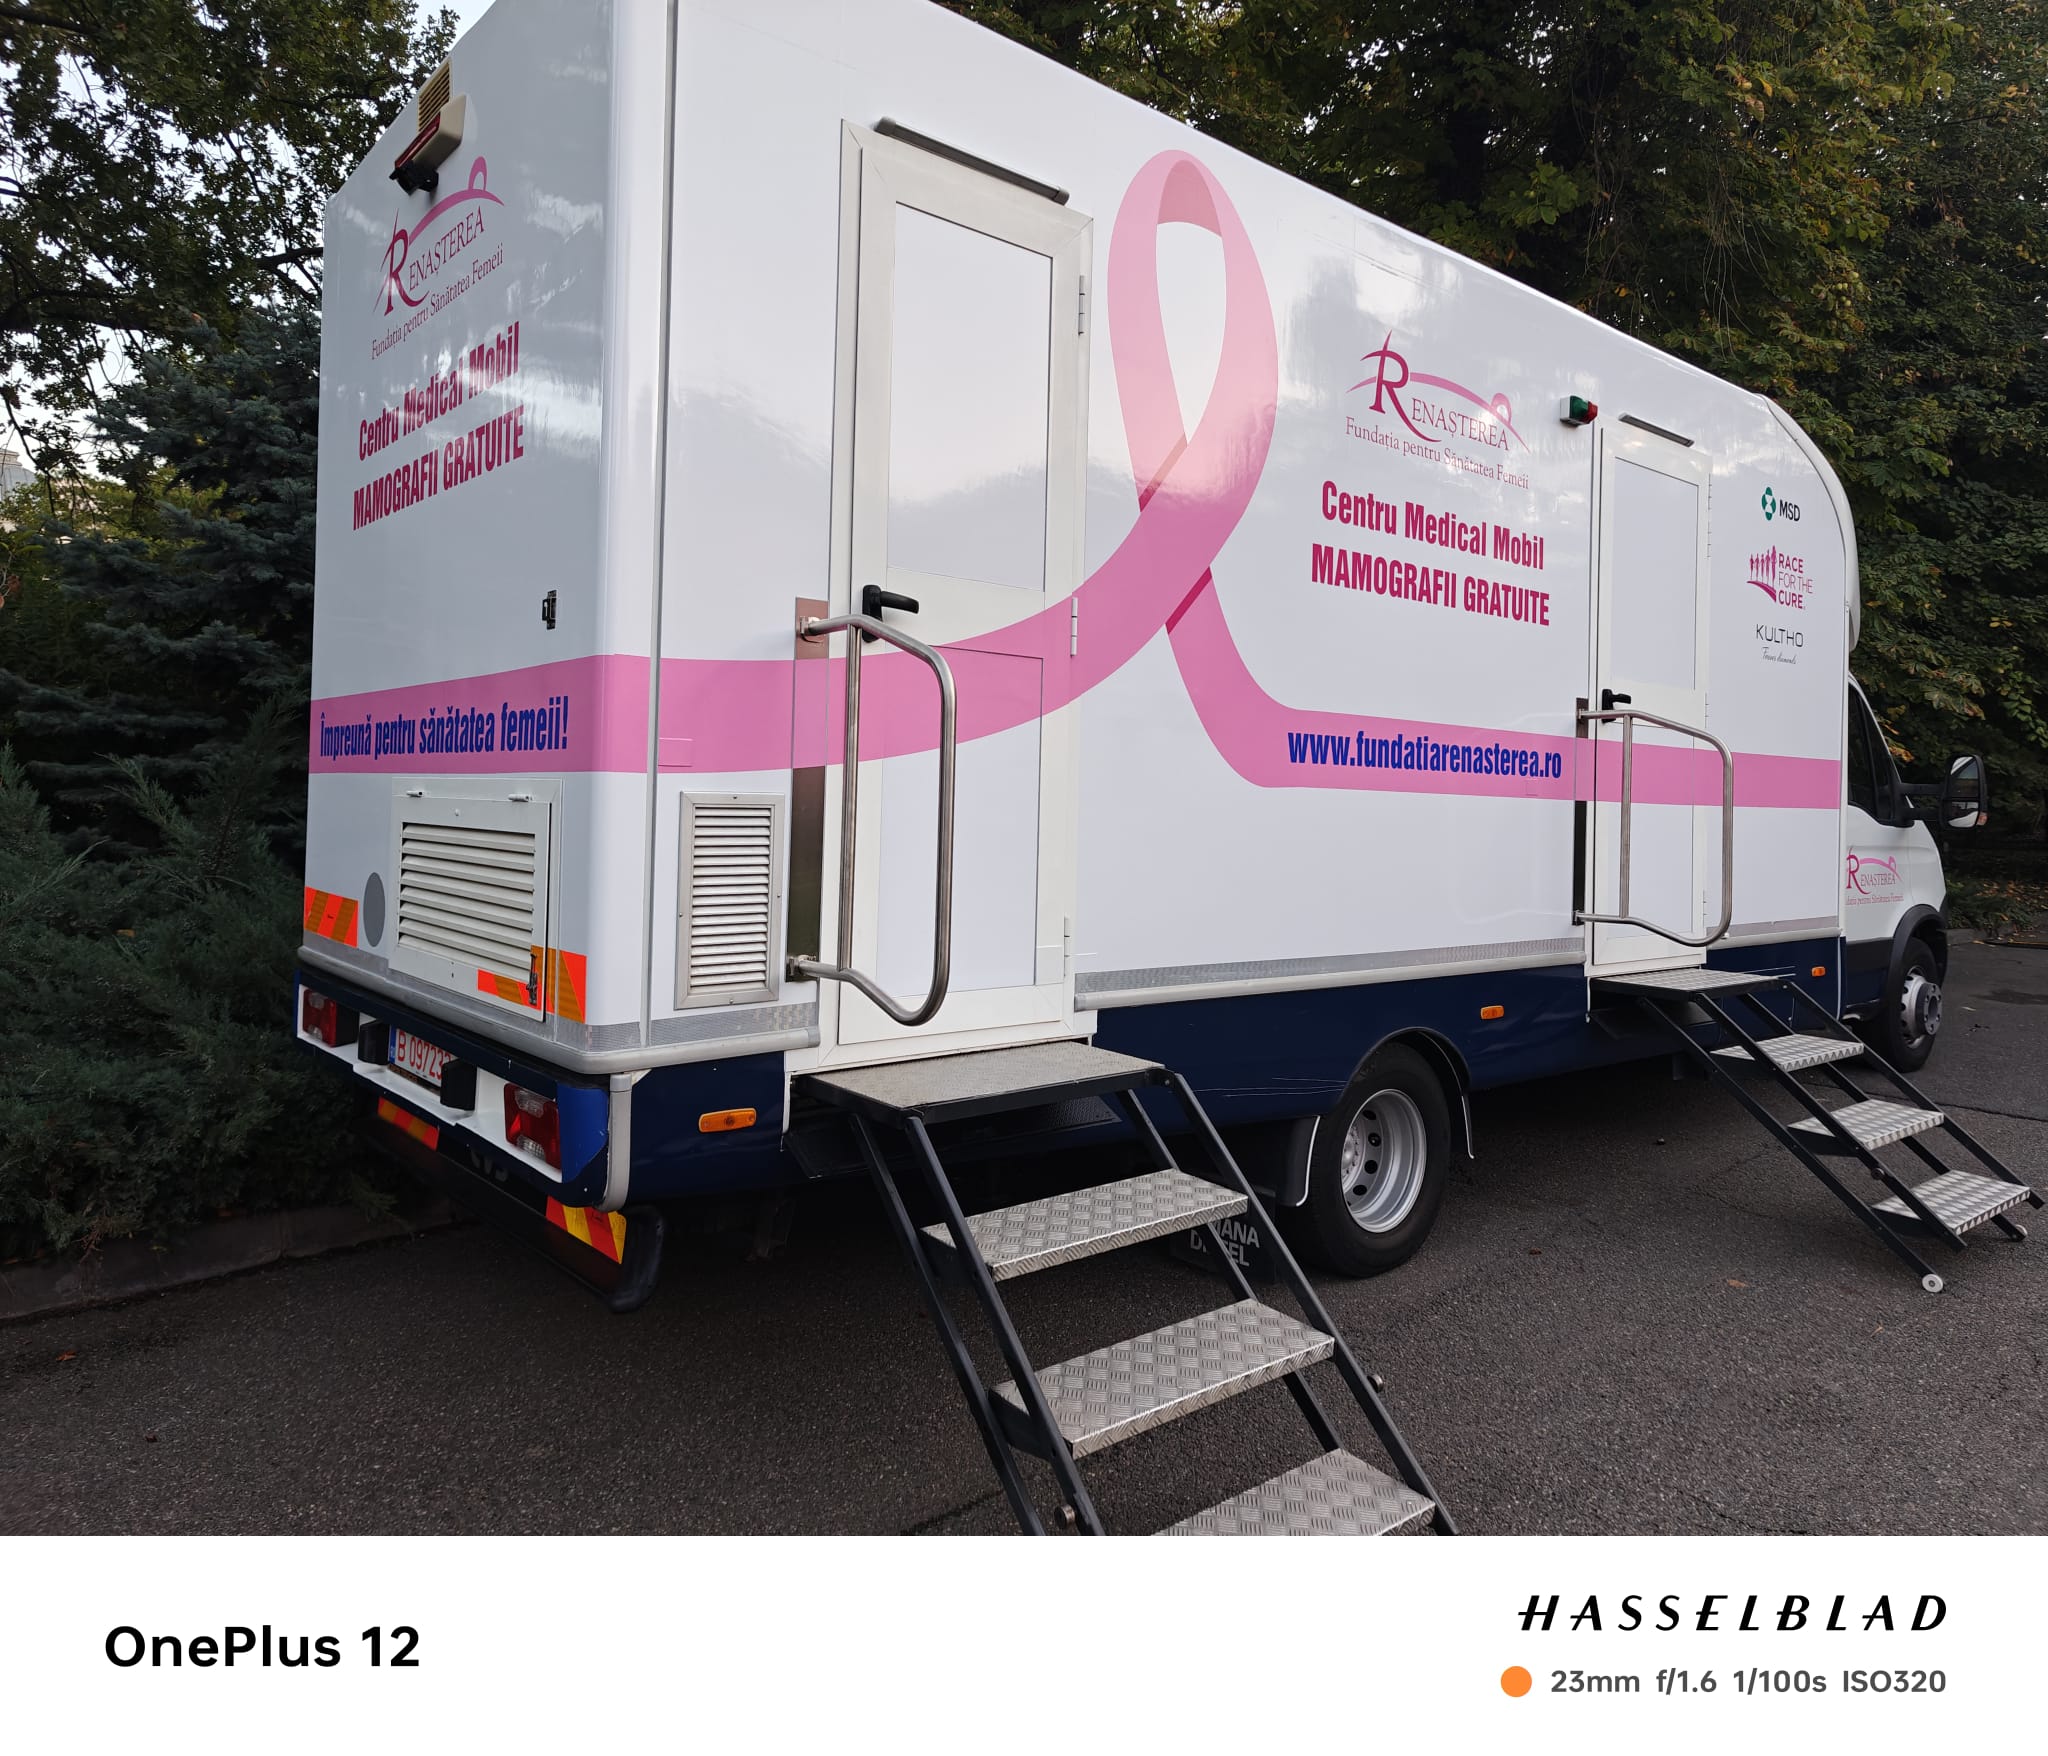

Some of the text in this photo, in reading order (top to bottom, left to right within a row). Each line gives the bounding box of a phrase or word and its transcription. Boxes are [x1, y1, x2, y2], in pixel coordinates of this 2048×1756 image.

[403, 305, 429, 341] pentru
[472, 242, 503, 285] Femeii
[359, 321, 520, 461] Centru Medical Mobil
[353, 405, 525, 531] MAMOGRAFII GRATUITE
[1403, 440, 1441, 461] pentru
[1497, 463, 1529, 490] Femeii
[1321, 480, 1544, 570] Centru Medical Mobil
[1779, 499, 1801, 522] MSD
[1311, 543, 1550, 626] MAMOGRAFII GRATUITE
[1778, 553, 1804, 574] RACE
[1778, 571, 1813, 594] FOR THE
[1756, 623, 1804, 648] KULTHO
[320, 695, 569, 761] Împreună pentru sănătatea femeii!
[1287, 730, 1562, 779] www.fundatiarenasterea.ro
[397, 1029, 406, 1062] B
